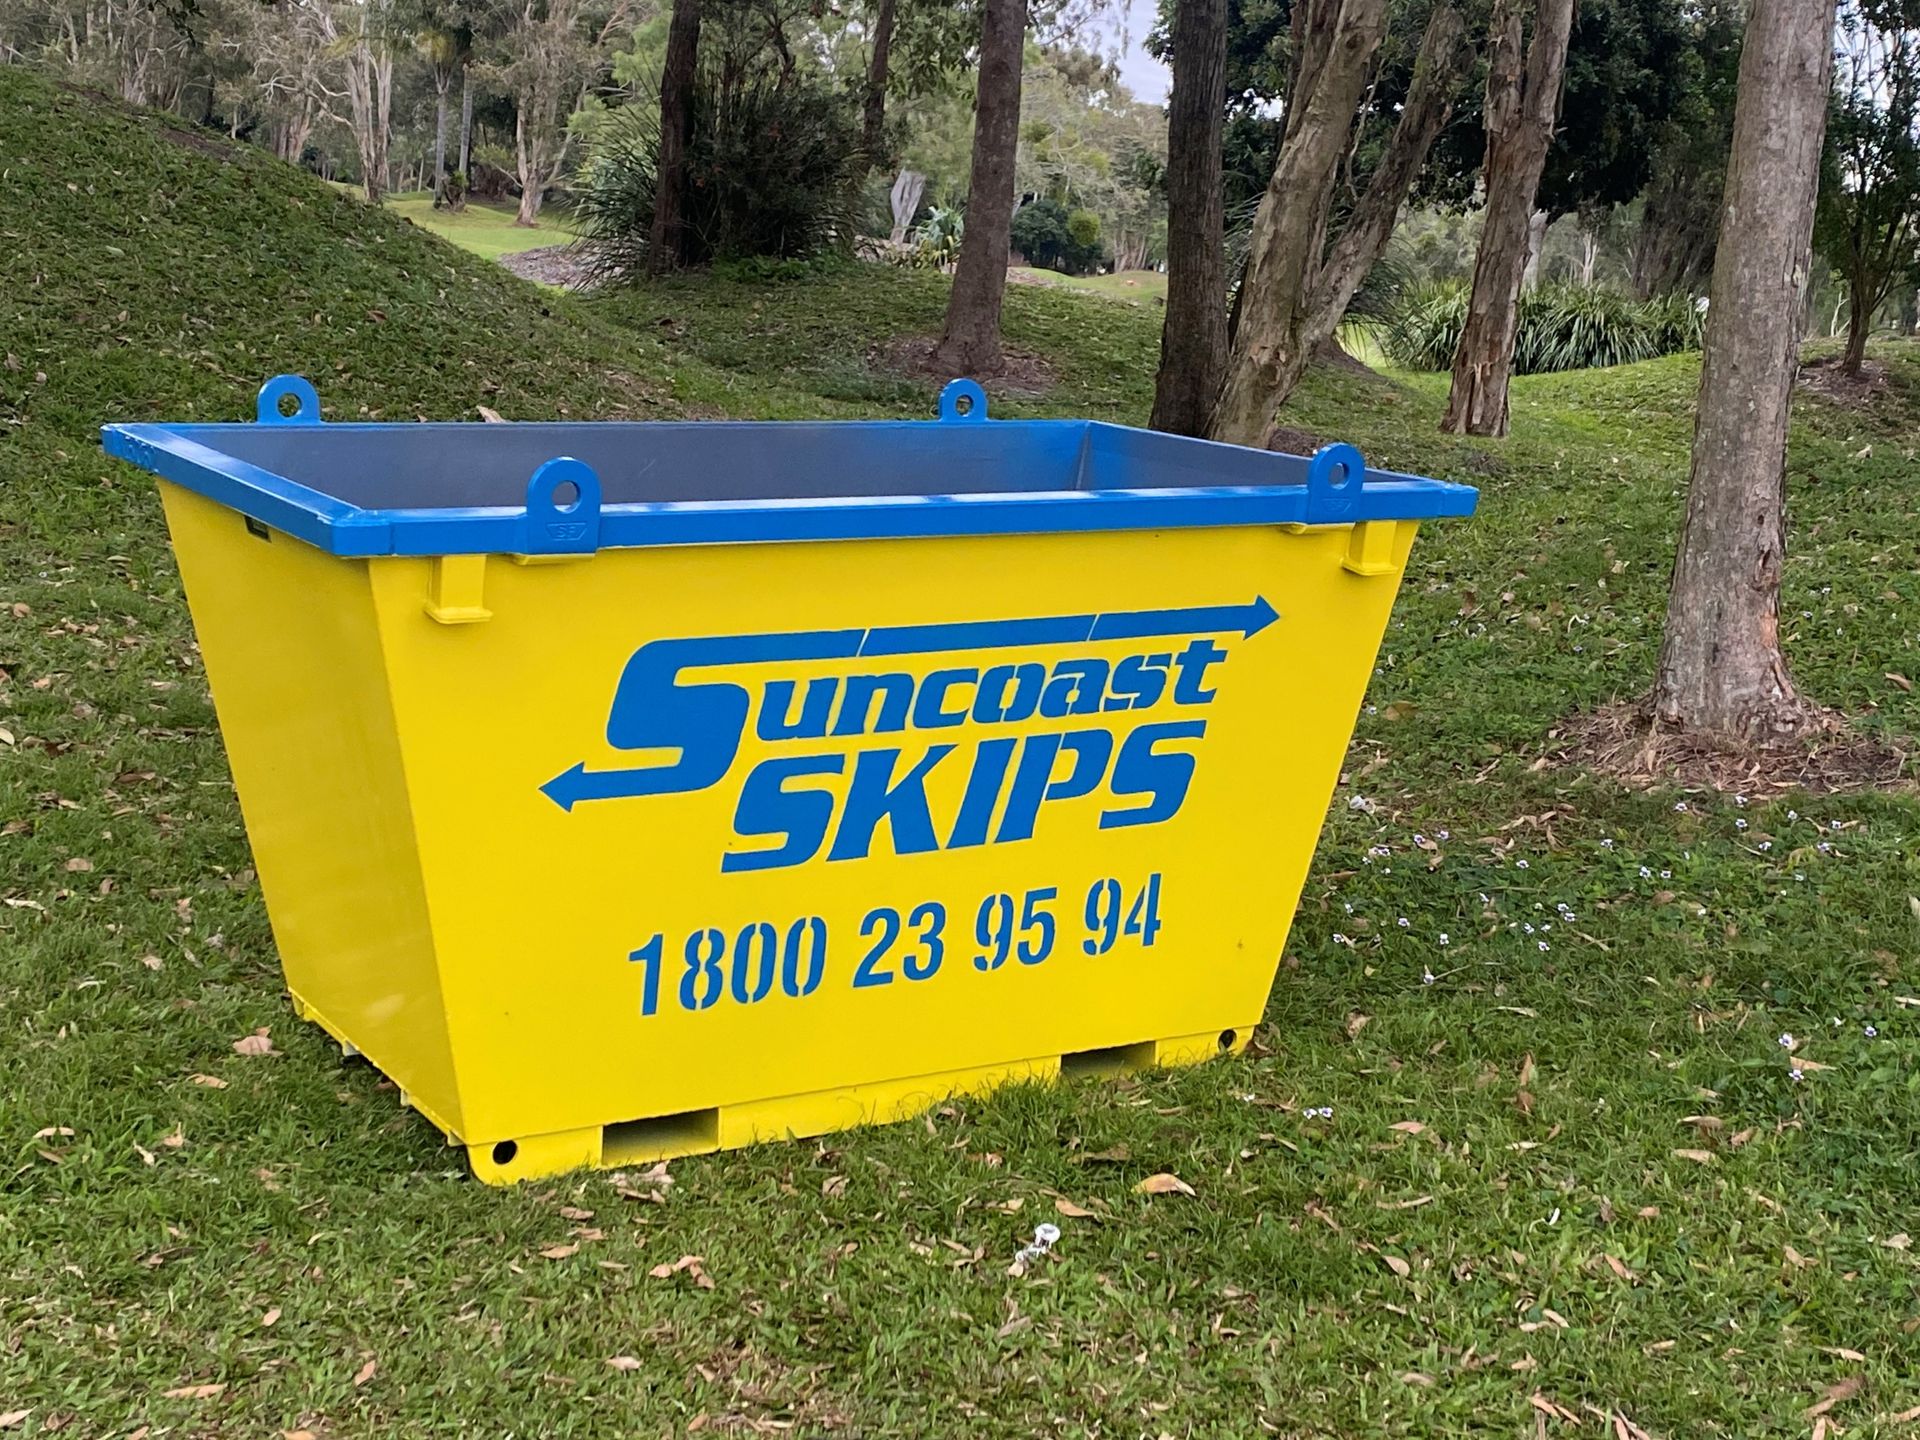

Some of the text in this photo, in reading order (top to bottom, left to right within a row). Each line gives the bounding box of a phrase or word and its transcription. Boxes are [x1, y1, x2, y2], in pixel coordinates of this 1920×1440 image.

[605, 636, 1228, 796] Suncoast
[721, 720, 1206, 873] SKIPS
[629, 873, 1162, 1016] 1800 23 95 94
